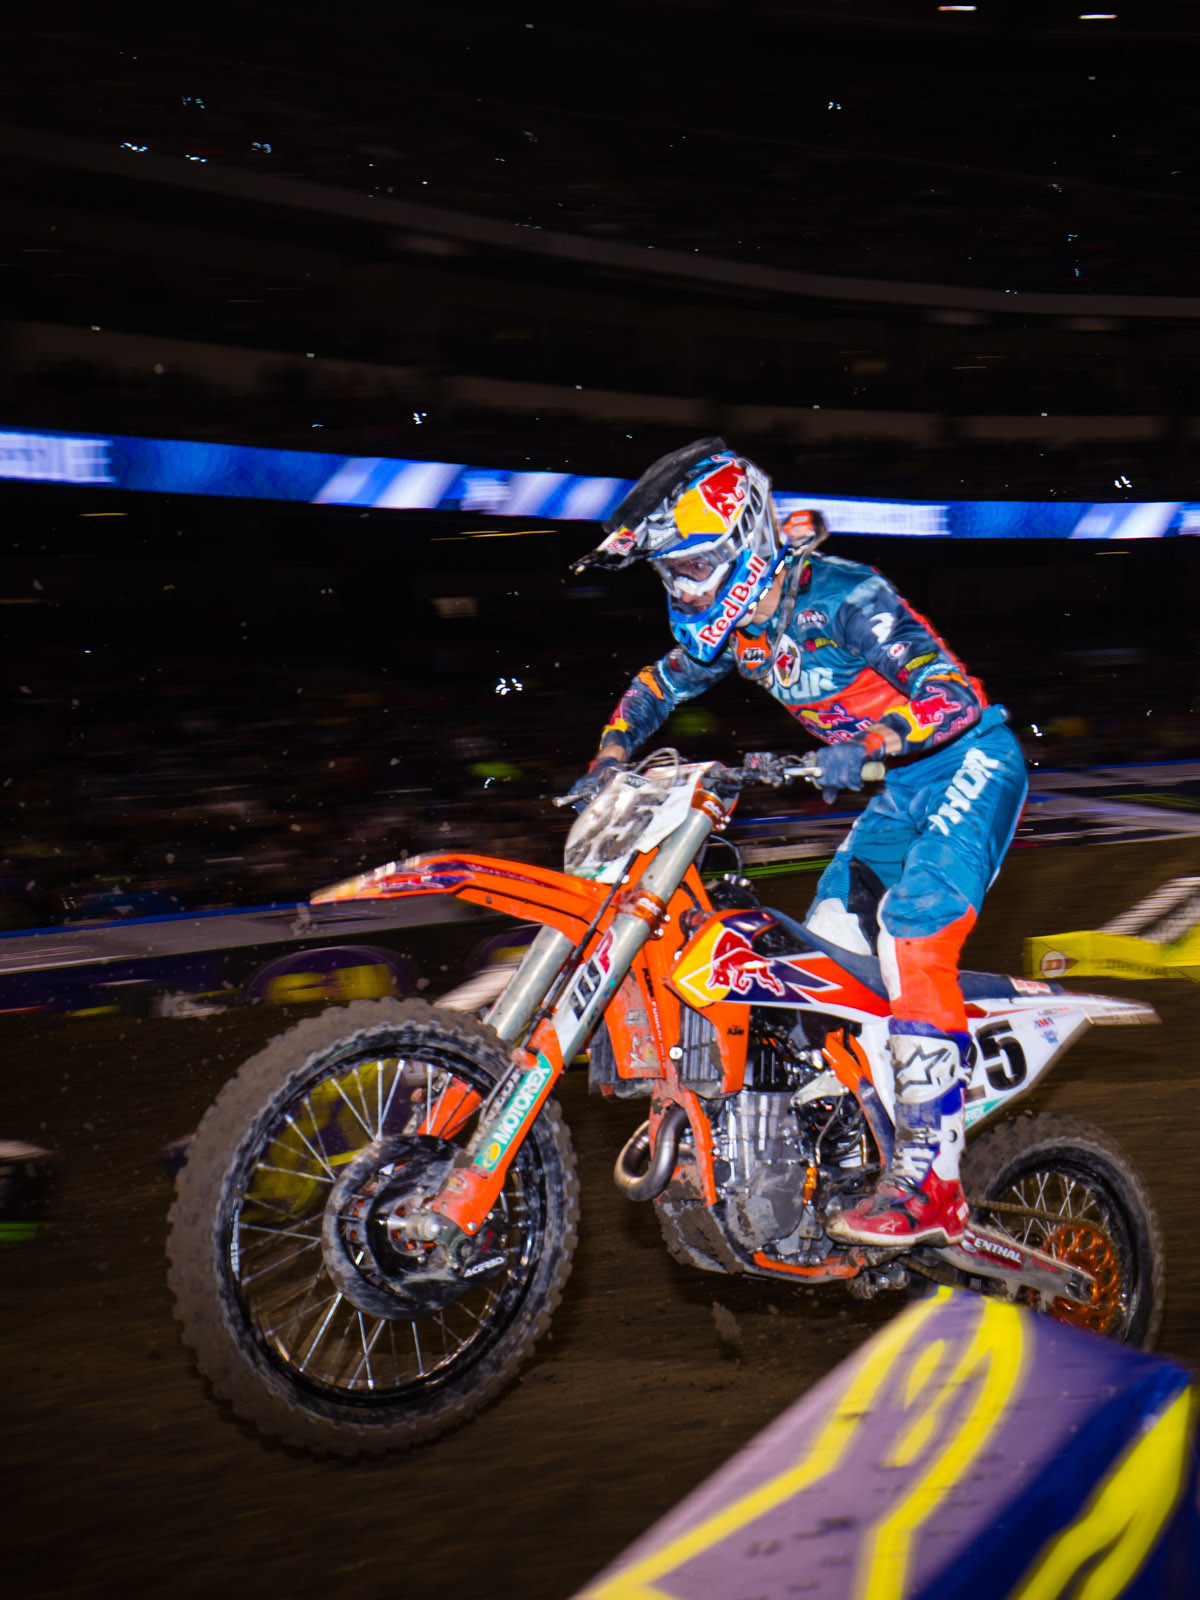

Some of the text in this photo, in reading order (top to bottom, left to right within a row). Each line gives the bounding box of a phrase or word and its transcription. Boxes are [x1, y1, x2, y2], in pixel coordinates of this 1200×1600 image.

[697, 553, 767, 647] Red Bull
[726, 1024, 745, 1036] KTM
[965, 1019, 1028, 1103] 5
[491, 1066, 551, 1145] MOTOREX
